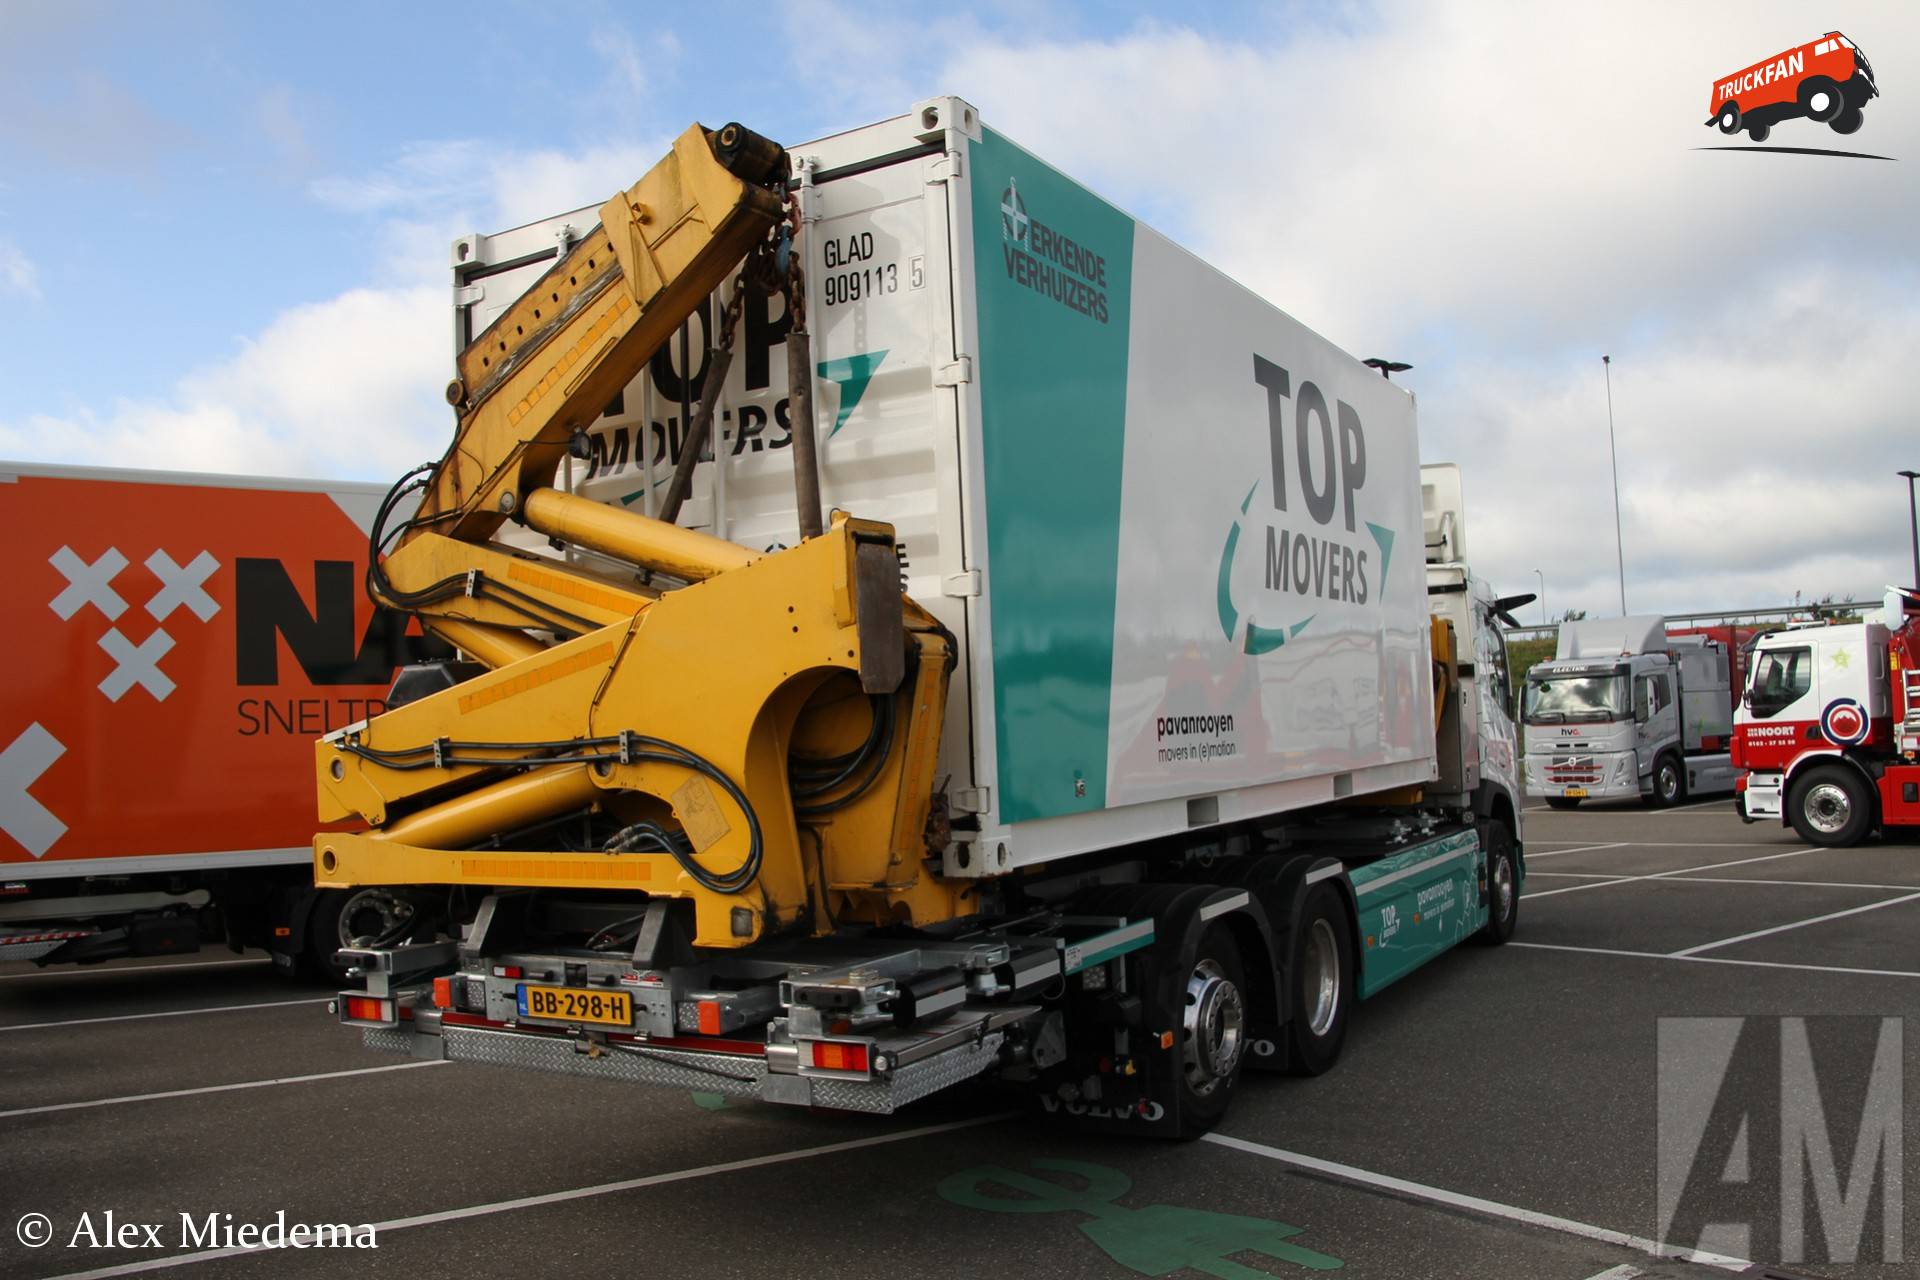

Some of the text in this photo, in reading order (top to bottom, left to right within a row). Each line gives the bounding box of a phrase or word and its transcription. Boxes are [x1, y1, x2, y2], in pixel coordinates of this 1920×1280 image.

[824, 231, 873, 269] GLAD
[1030, 218, 1107, 289] ERKENDE
[825, 257, 923, 306] 909113 5
[1003, 242, 1109, 324] VERHUIZERS
[1253, 352, 1366, 533] TOP
[1265, 525, 1368, 605] MOVERS
[1157, 714, 1234, 742] pavanrooyen
[1758, 726, 1795, 737] NOORT
[1158, 740, 1237, 763] movers in (e)motion
[532, 990, 625, 1020] BB-298-H
